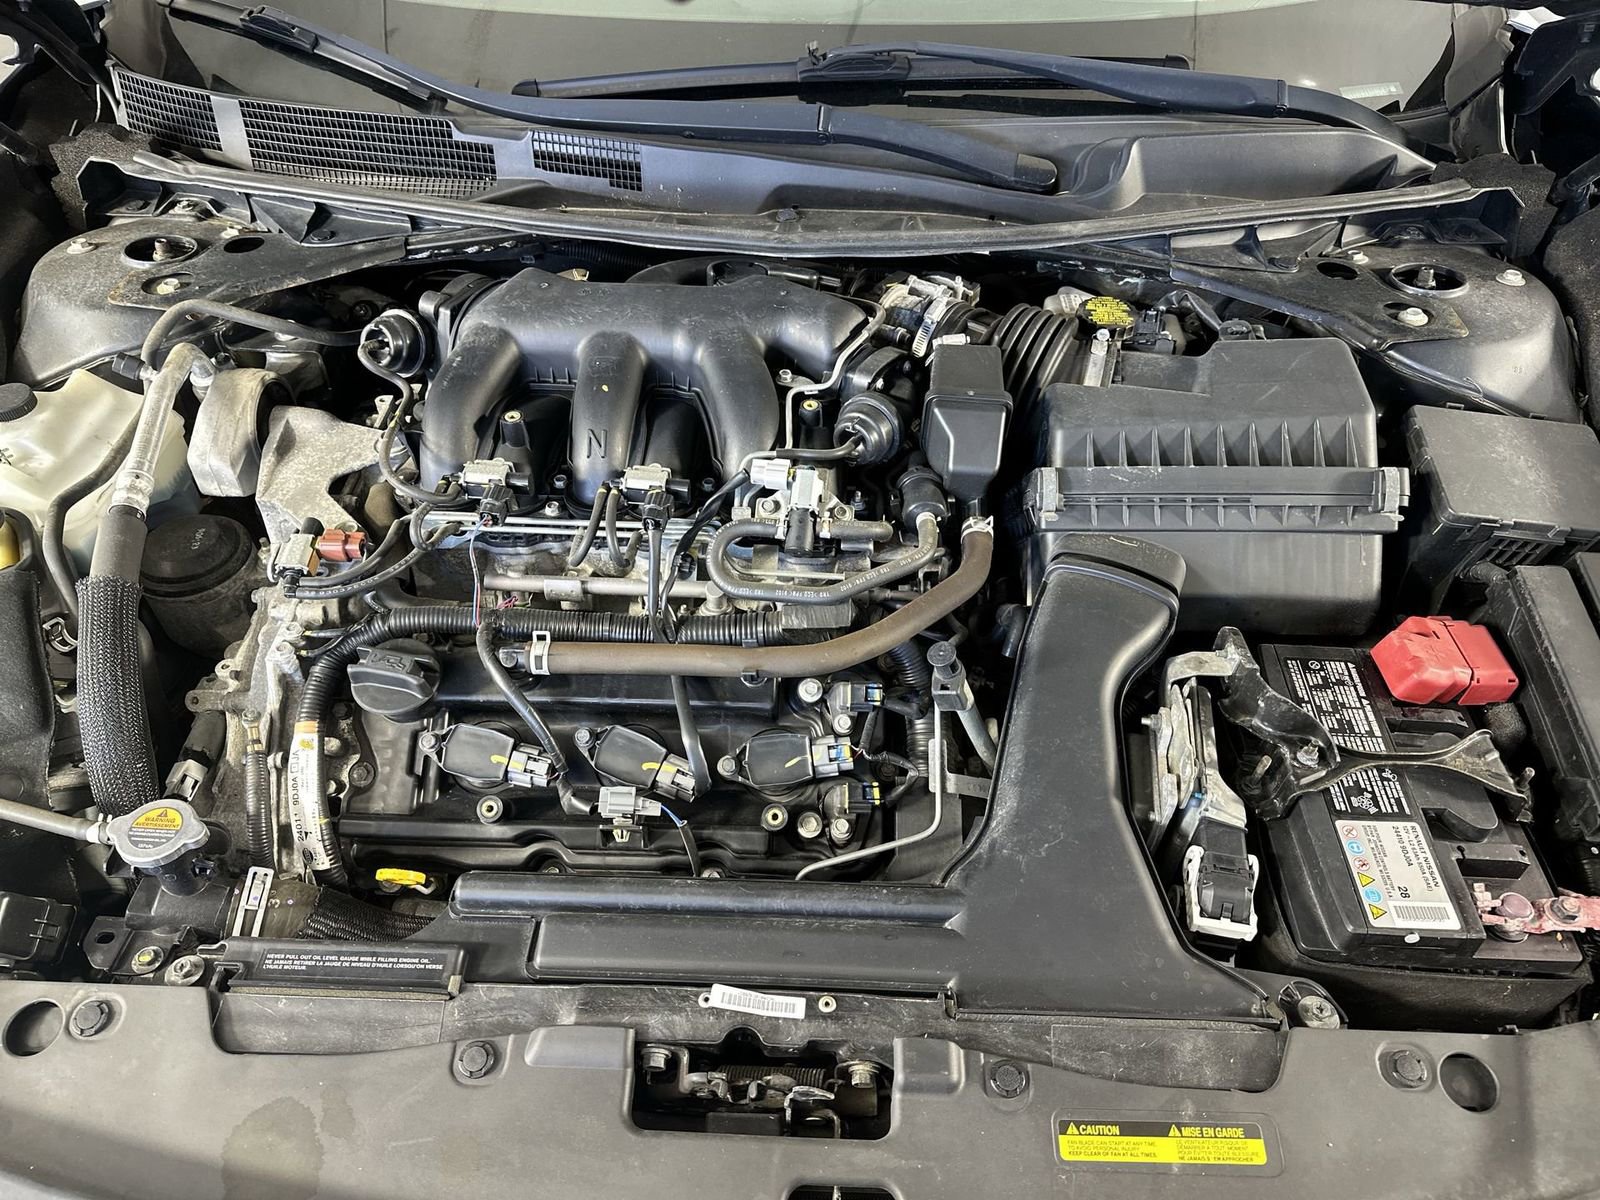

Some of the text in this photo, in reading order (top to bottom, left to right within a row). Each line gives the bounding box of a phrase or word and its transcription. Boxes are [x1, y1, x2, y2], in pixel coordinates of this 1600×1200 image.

[1410, 825, 1440, 887] RENAULT NISSAN
[1398, 886, 1411, 898] 28
[1079, 1125, 1120, 1135] CAUTION
[1181, 1127, 1245, 1138] MISE EN GARDE
